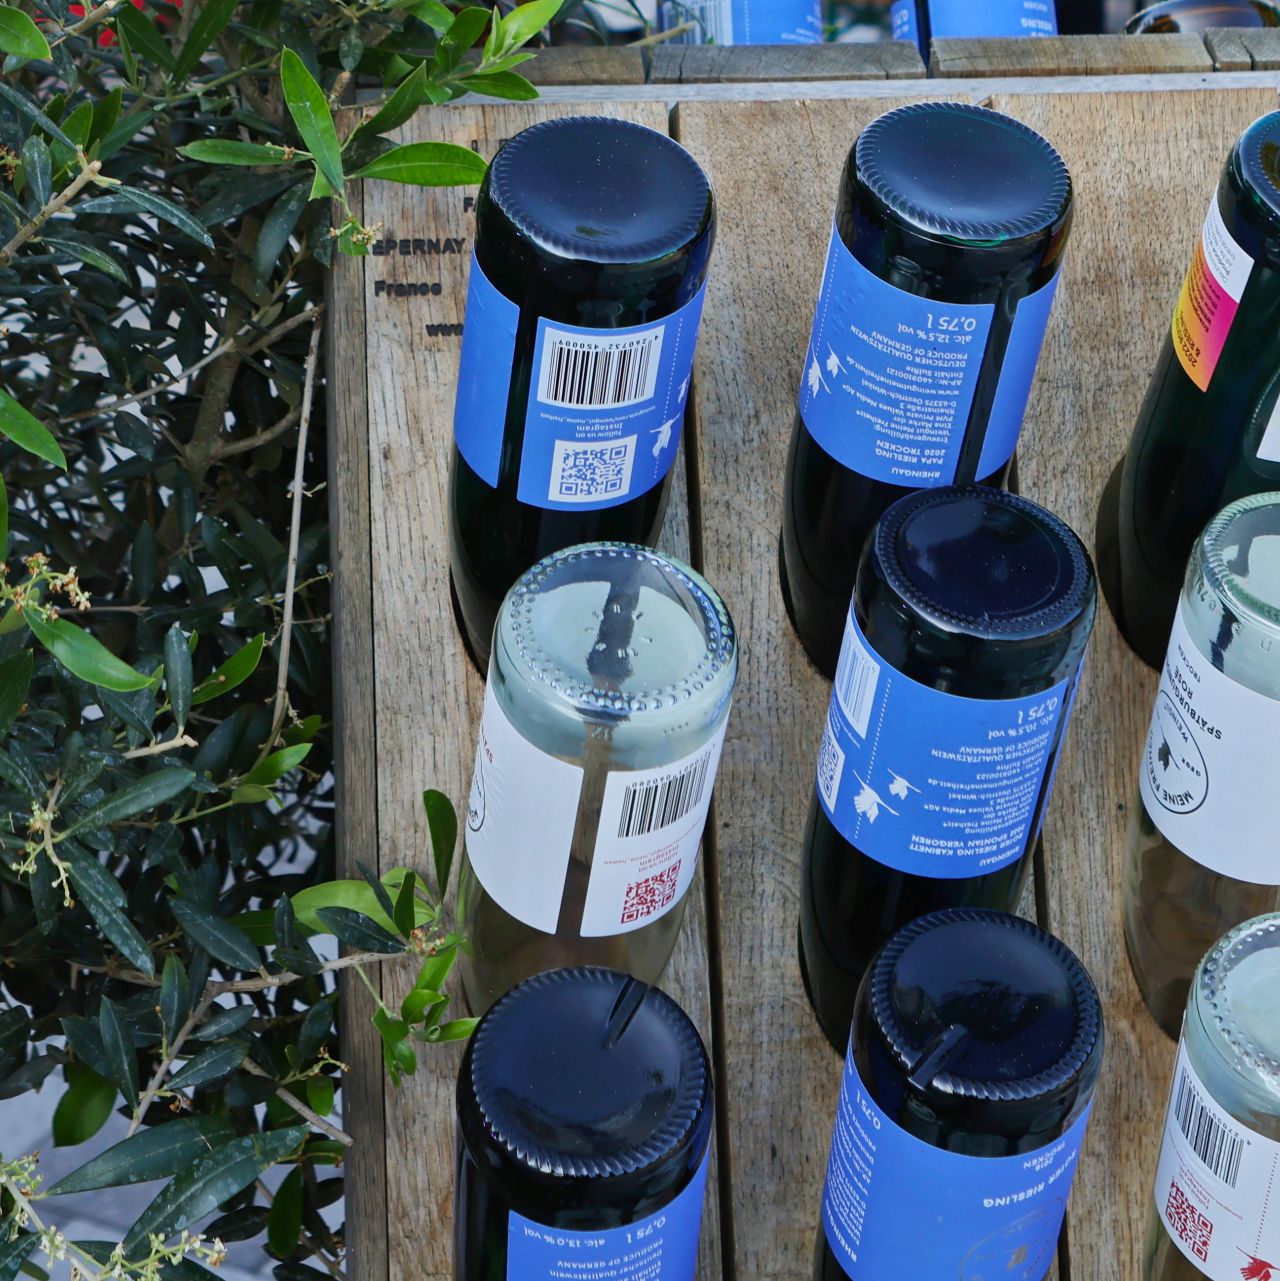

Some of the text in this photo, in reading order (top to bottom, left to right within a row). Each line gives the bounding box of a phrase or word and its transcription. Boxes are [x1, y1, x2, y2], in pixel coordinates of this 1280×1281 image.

[938, 316, 976, 331] 0,75
[897, 322, 971, 343] alc. 12,5 vol
[558, 338, 646, 350] 260732 450009
[850, 325, 965, 368] DEUTSCHER QUALITÄTSWEIN
[871, 331, 967, 360] PRODUCE OF GERMANY
[905, 365, 963, 378] Enthält Sulfite
[856, 391, 952, 422] PVM Private Values Media
[576, 422, 622, 432] Instagram
[889, 422, 949, 436] Weingut Meine
[892, 415, 951, 429] Eine Marke der
[596, 429, 621, 438] Follow
[876, 439, 945, 456] 2020 TROCKEN
[874, 447, 943, 464] PAPA RIESLING
[891, 466, 940, 478] RHEINGAU
[1173, 665, 1193, 699] ROSÉ
[1028, 696, 1057, 719] 0,75
[987, 730, 1004, 739] vol
[1004, 743, 1014, 751] OF
[930, 749, 1002, 762] QUALITÄTSWEIN
[1159, 789, 1194, 804] MEINE
[908, 832, 1022, 855] ROTER RIESLING KABINETT
[911, 834, 963, 848] VERGOREN
[967, 833, 1007, 846] SPONTAN
[979, 845, 1018, 865] RHEINGAU
[982, 1181, 1046, 1208] RIESLING
[523, 1226, 540, 1238] vol
[636, 1216, 665, 1239] 0,75
[584, 1238, 604, 1247] alc.
[557, 1257, 619, 1268] OF GERMANY
